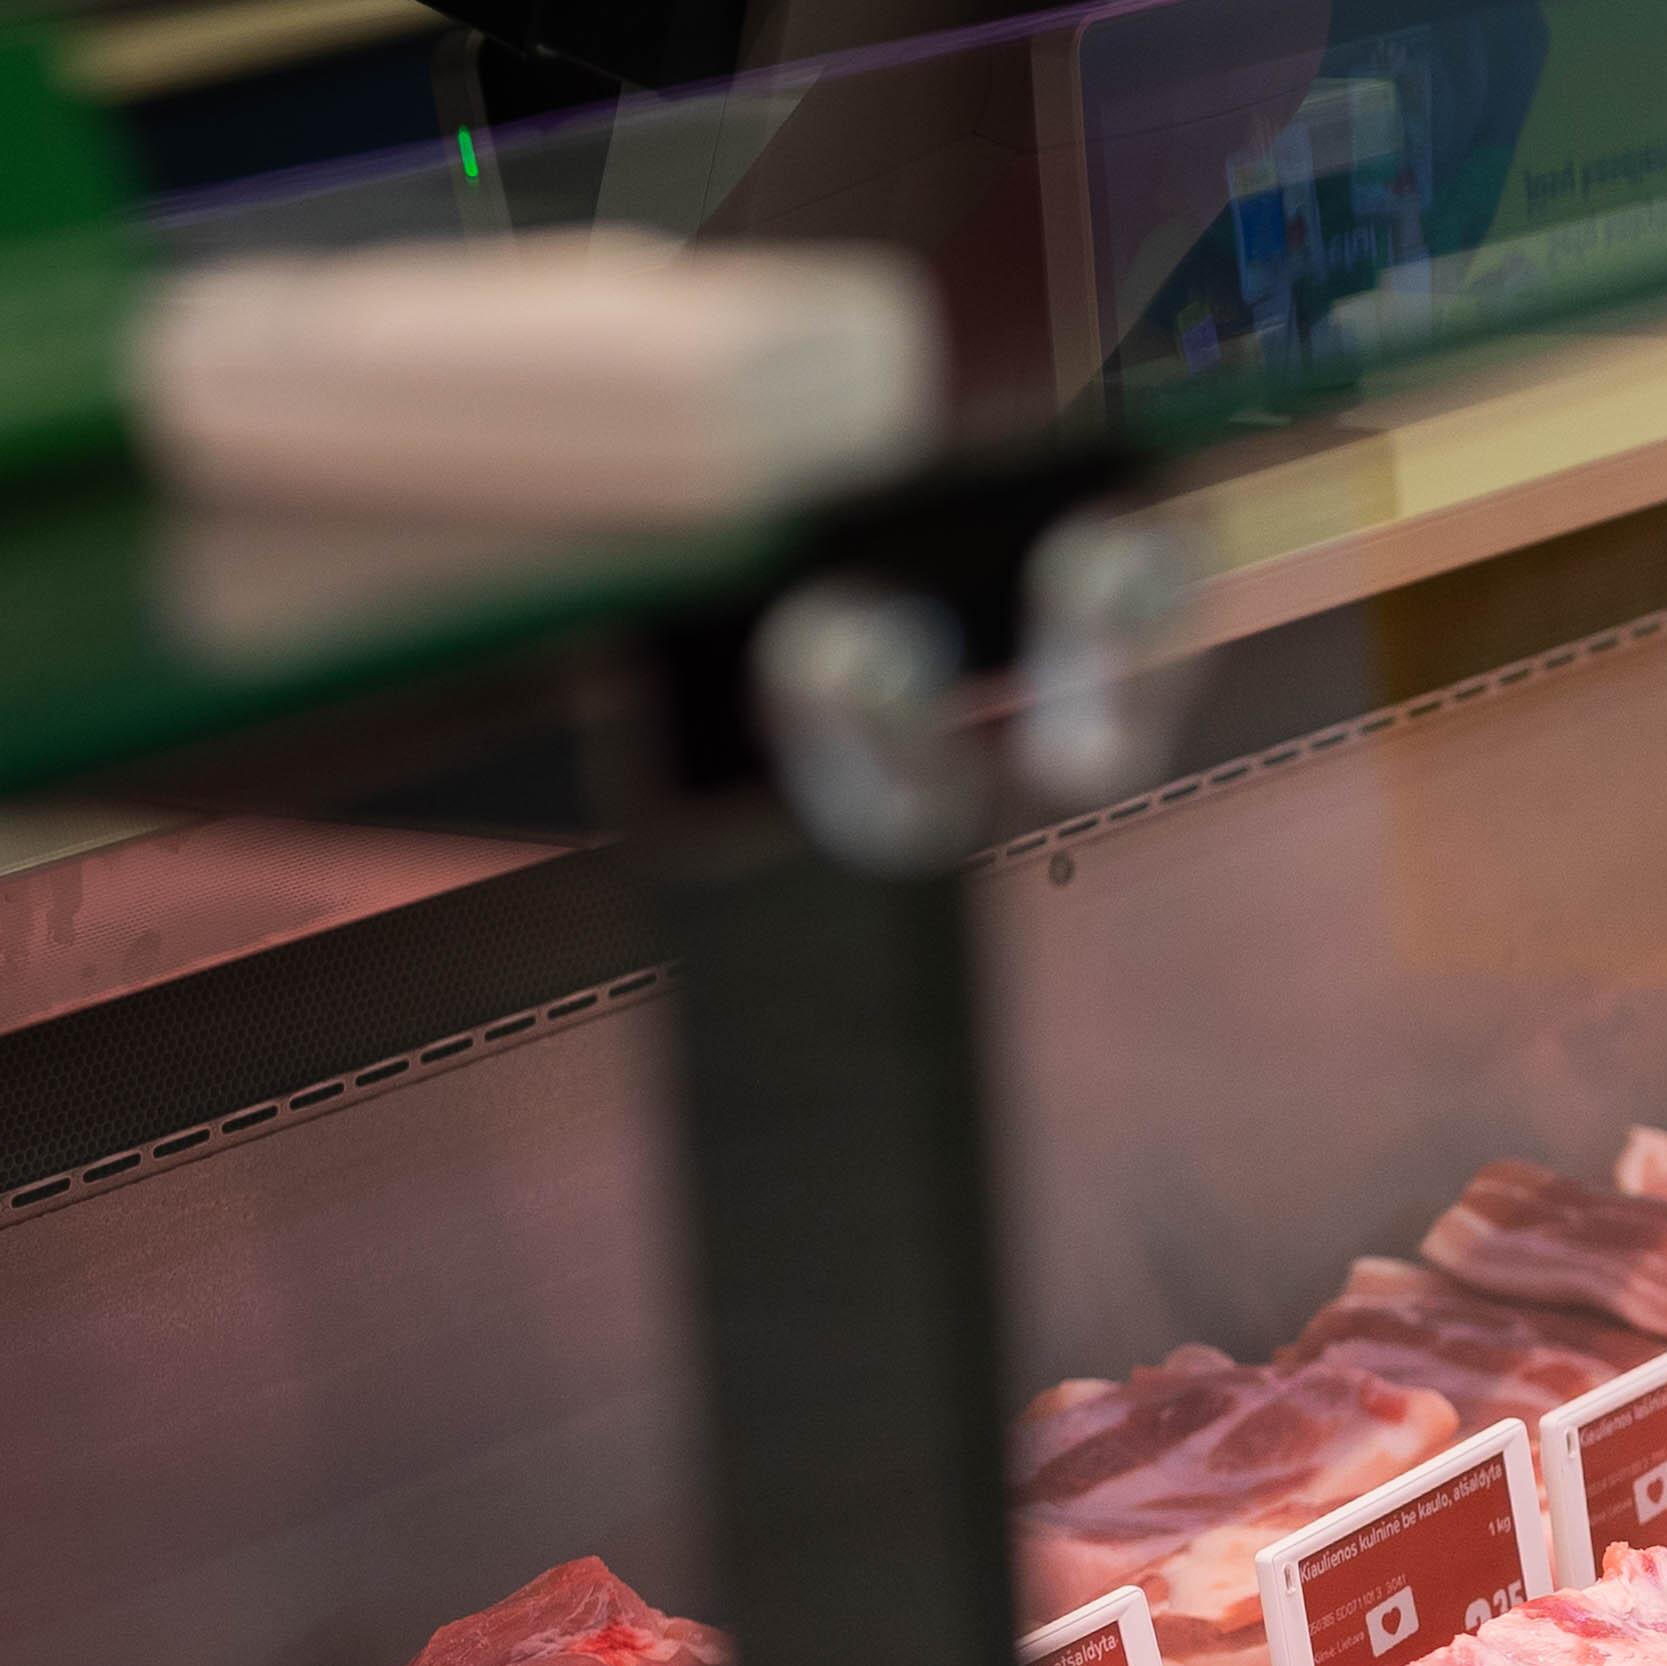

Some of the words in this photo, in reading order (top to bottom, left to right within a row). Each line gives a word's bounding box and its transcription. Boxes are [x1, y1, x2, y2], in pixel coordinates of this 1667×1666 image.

[1300, 1541, 1358, 1583] Kiaulienos
[1359, 1515, 1401, 1552] kulninė
[1402, 1508, 1417, 1528] be
[1418, 1493, 1452, 1517] kaulo,
[1453, 1463, 1502, 1501] atšaldyta
[1497, 1516, 1511, 1534] kg
